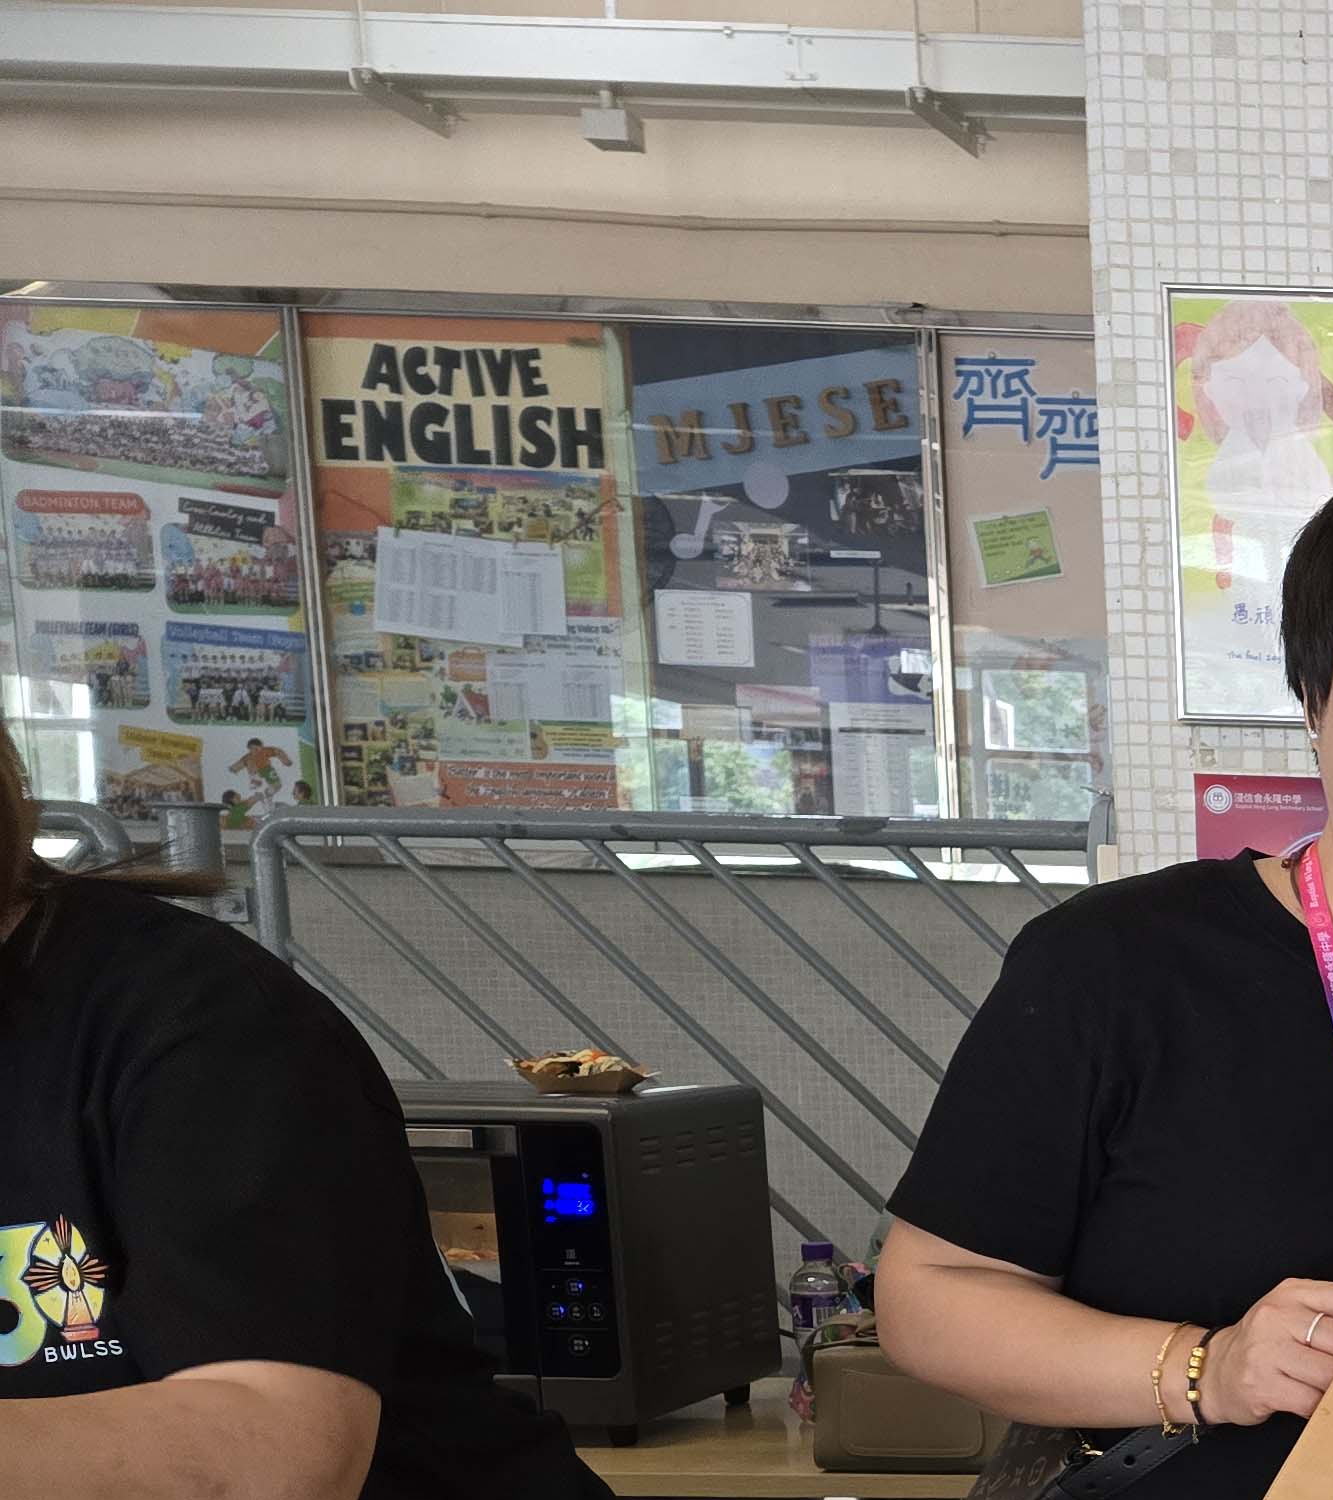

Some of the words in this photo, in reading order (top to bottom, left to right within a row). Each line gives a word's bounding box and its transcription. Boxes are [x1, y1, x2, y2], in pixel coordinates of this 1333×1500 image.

[362, 343, 549, 398] ACTIVE
[320, 398, 605, 470] ENGLISH
[653, 377, 911, 466] MJESE
[44, 1339, 124, 1363] BWLSS
